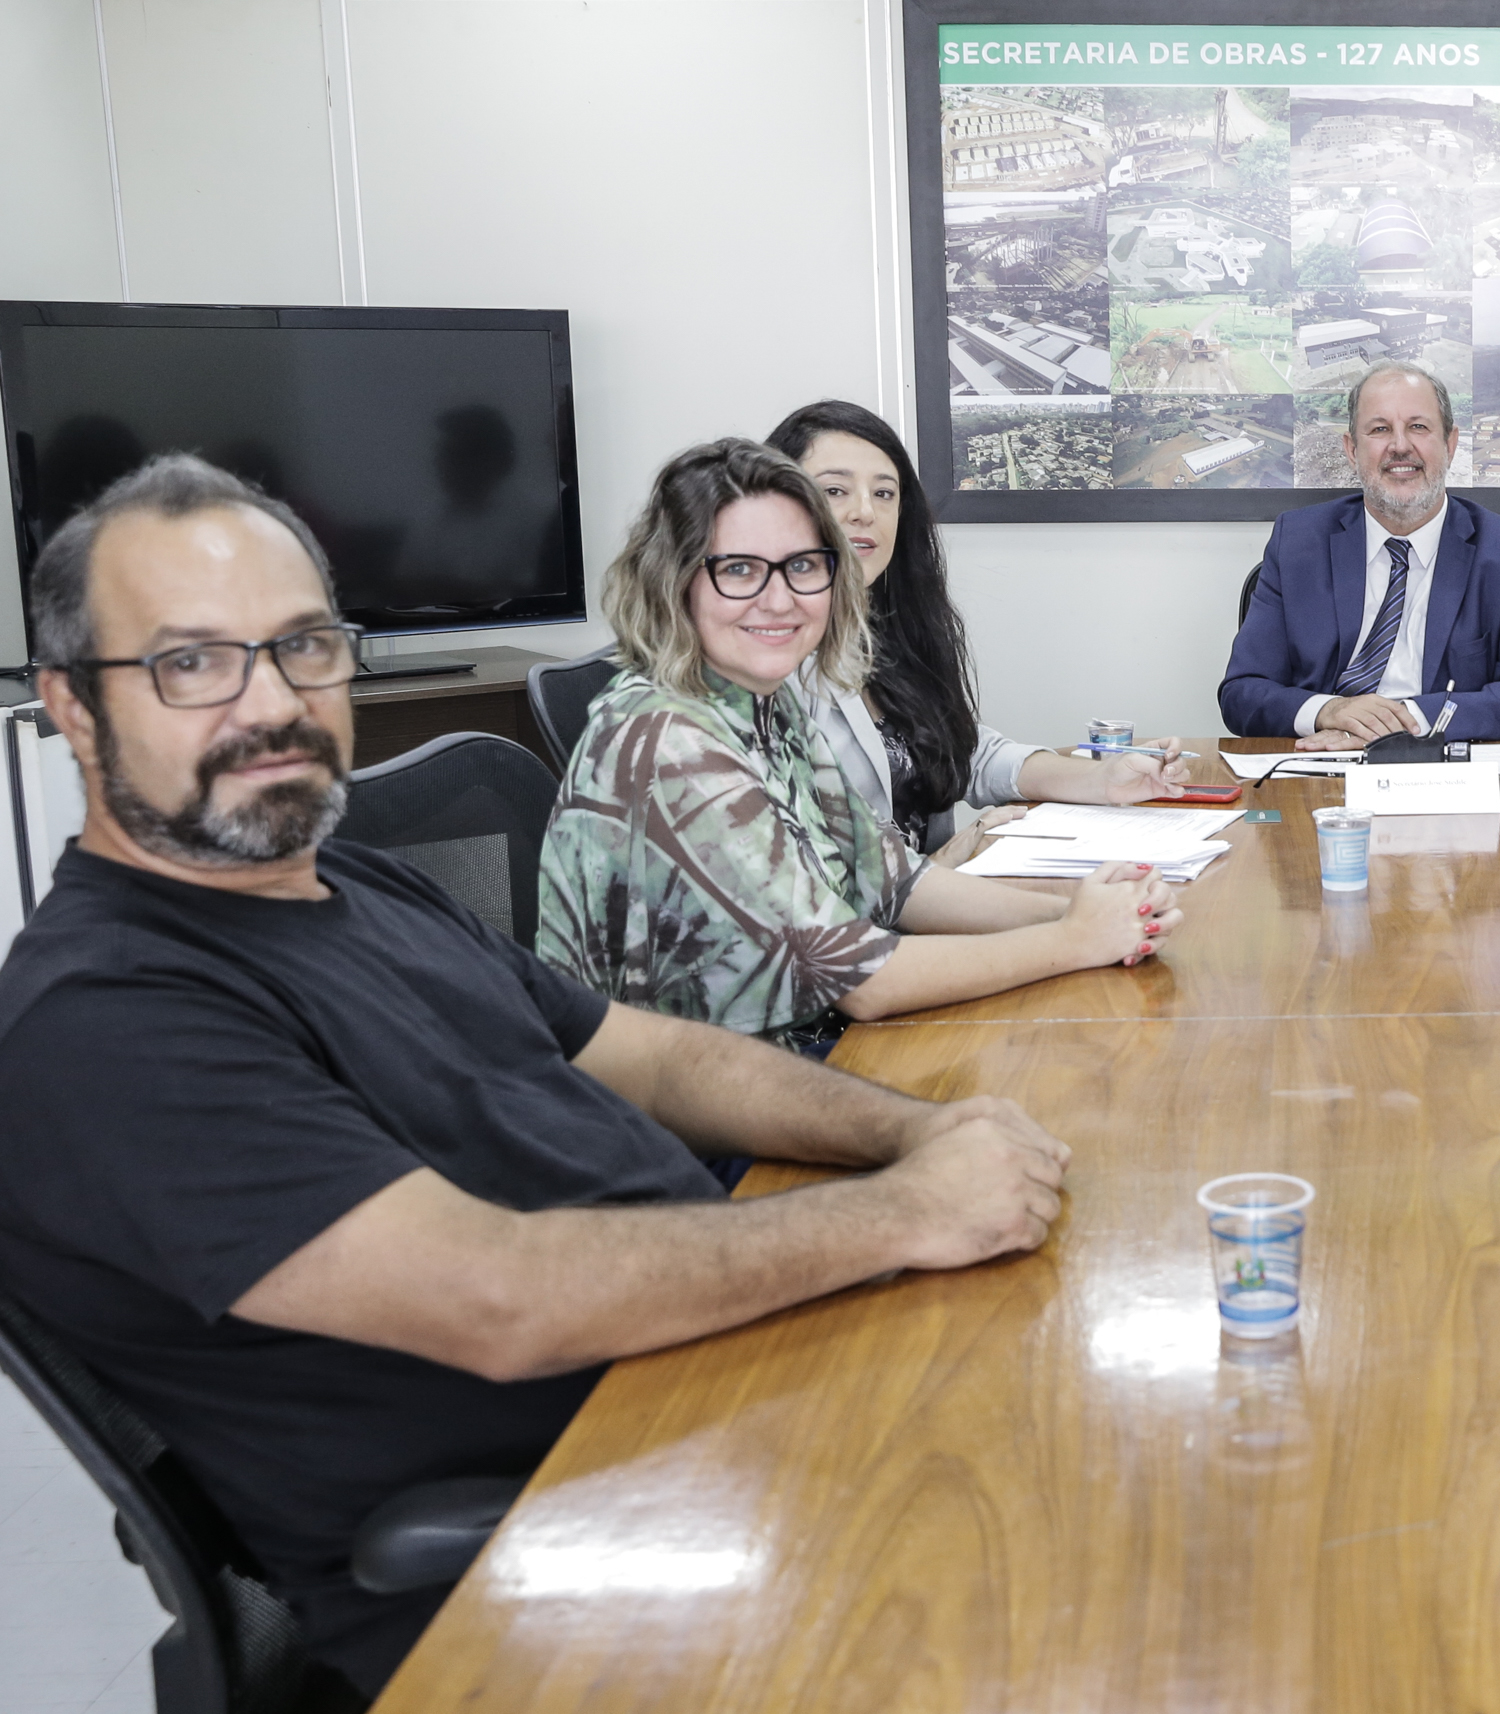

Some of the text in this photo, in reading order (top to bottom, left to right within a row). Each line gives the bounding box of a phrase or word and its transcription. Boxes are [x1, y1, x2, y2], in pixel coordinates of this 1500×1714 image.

[943, 41, 1141, 65] SECRETARIA
[1149, 41, 1190, 65] DE
[1199, 41, 1307, 66] OBRAS
[1336, 42, 1384, 66] 127
[1392, 43, 1481, 67] ANOS
